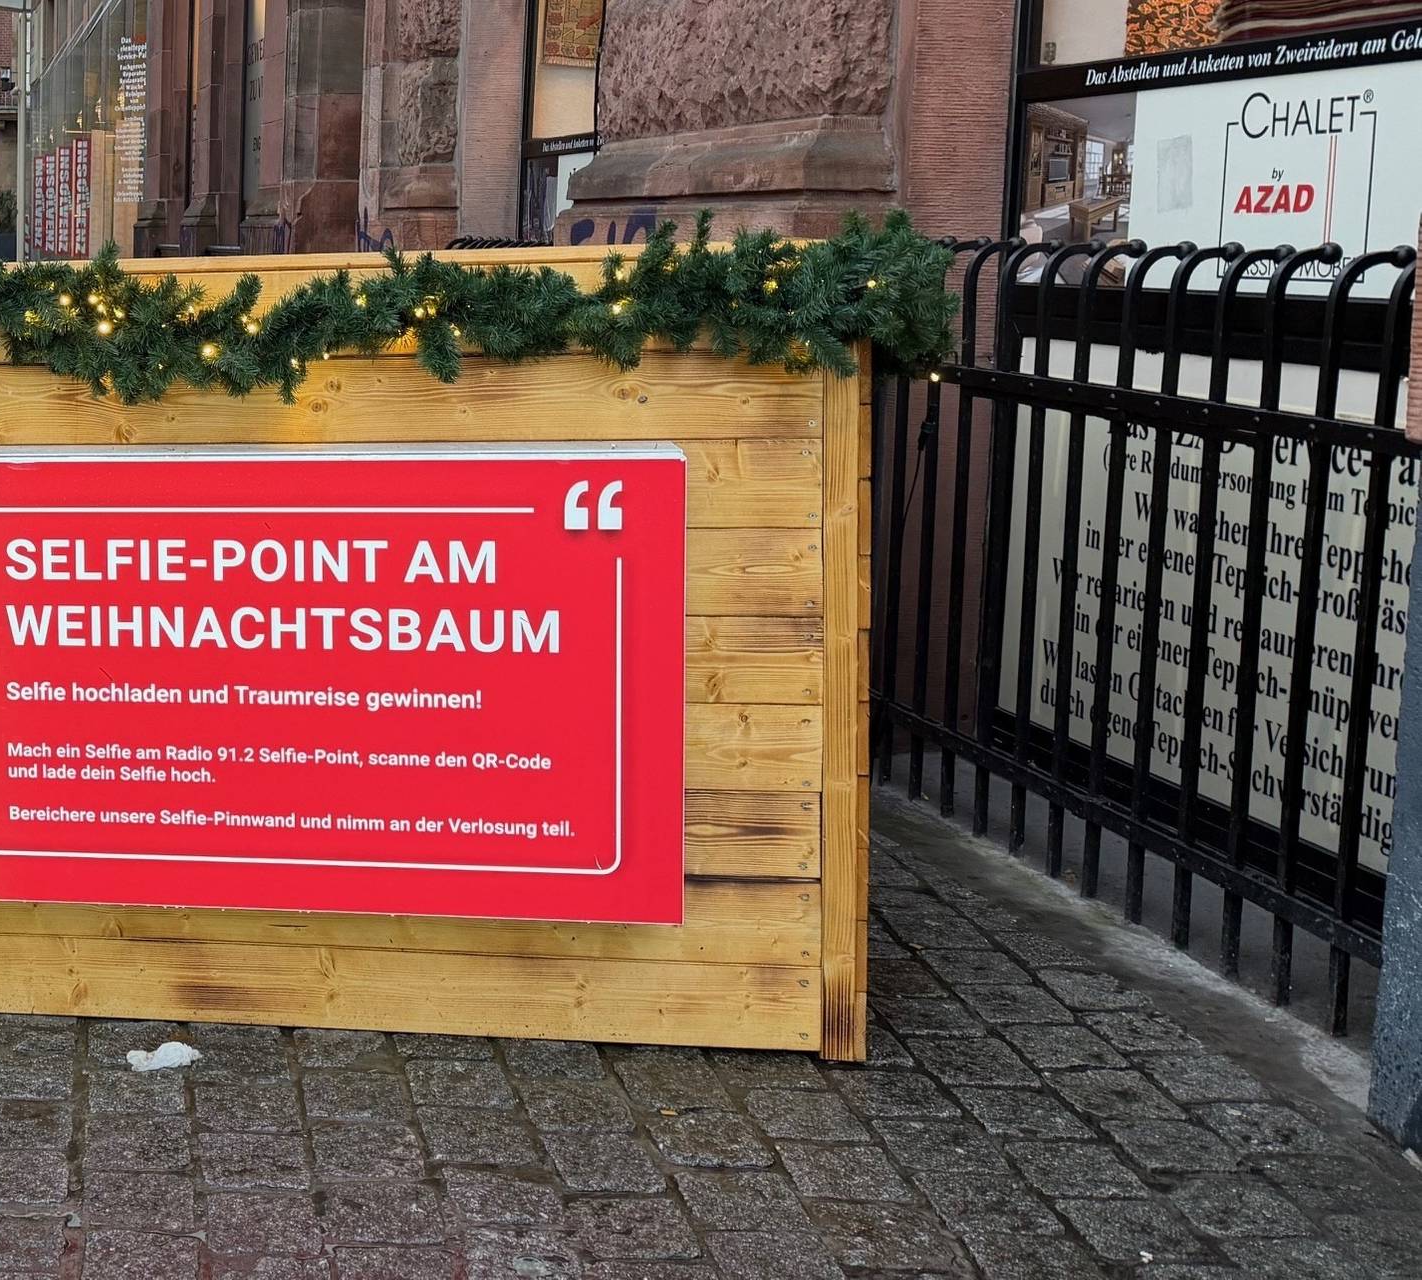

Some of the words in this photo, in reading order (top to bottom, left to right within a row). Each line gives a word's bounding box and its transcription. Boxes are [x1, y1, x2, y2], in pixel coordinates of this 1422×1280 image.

[1086, 69, 1106, 86] Das
[1108, 62, 1160, 83] Abstellen
[1163, 60, 1186, 77] und
[1188, 55, 1245, 75] Anketten
[1248, 54, 1271, 68] von
[1275, 43, 1358, 66] Zweirädern
[1361, 39, 1386, 56] am
[1271, 168, 1284, 182] by
[1234, 183, 1315, 214] AZAD
[1085, 520, 1101, 551] in
[6, 539, 388, 583] SELFIE-POINT
[404, 541, 495, 583] AM
[6, 605, 560, 653] WEIHNACHTSBAUM
[1075, 604, 1090, 634] in
[1182, 603, 1217, 635] ud
[7, 682, 66, 701] Selfie
[72, 683, 181, 704] hochladen
[189, 685, 228, 704] und
[234, 686, 359, 707] Traumreise
[366, 688, 482, 712] gewinnen!
[1041, 679, 1084, 719] duch
[8, 743, 51, 758] Mach
[56, 744, 80, 758] ein
[85, 744, 131, 760] Selfie
[136, 749, 161, 760] am
[166, 746, 213, 761] Radio
[218, 747, 254, 762] 91.2
[259, 748, 364, 768] Selfie-Point,
[369, 754, 430, 767] scanne
[435, 752, 467, 767] den
[472, 753, 551, 770] QR-Code
[8, 764, 38, 778] und
[43, 764, 76, 779] lade
[81, 765, 115, 780] dein
[120, 766, 166, 781] Selfie
[171, 767, 216, 783] hoch.
[9, 805, 95, 823] Bereichere
[100, 812, 155, 824] unsere
[160, 809, 295, 828] Selfie-Pinnwand
[301, 814, 331, 829] und
[337, 815, 385, 831] nimm
[390, 820, 410, 831] an
[415, 817, 444, 832] der
[448, 818, 537, 839] Verlosung
[542, 821, 575, 837] teil.
